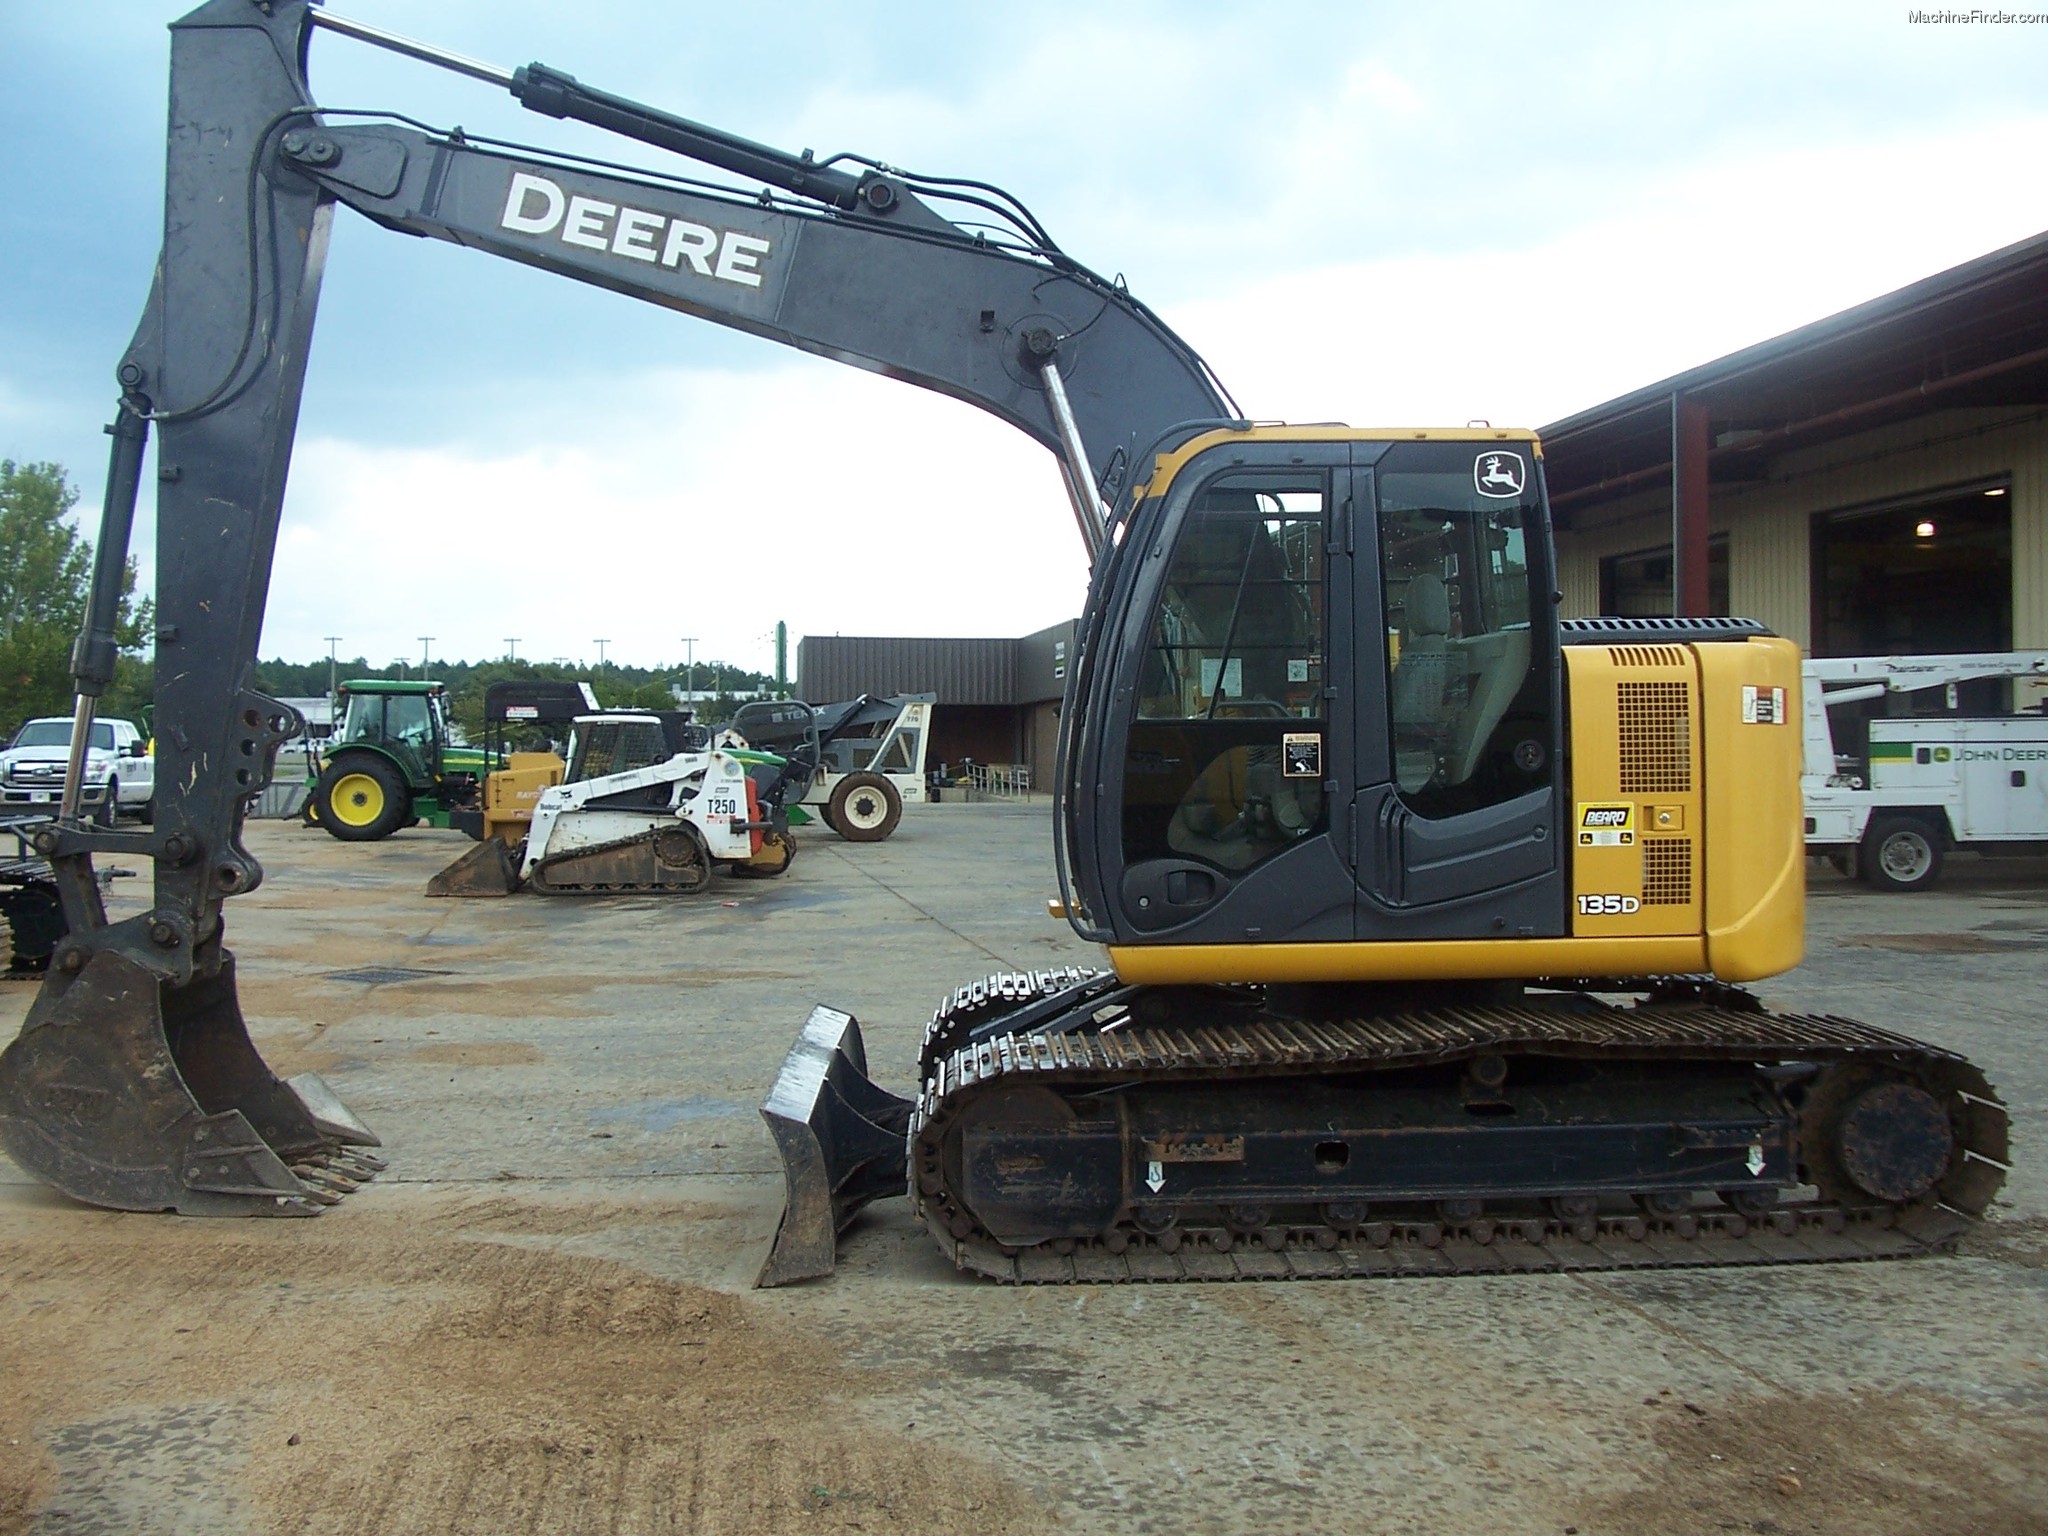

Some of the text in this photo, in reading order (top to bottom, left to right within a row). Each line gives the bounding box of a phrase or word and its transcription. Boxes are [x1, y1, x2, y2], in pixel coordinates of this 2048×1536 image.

[501, 172, 770, 287] DEERE
[1954, 748, 1999, 761] JOHN
[707, 799, 736, 814] T250
[1577, 894, 1640, 915] 135D
